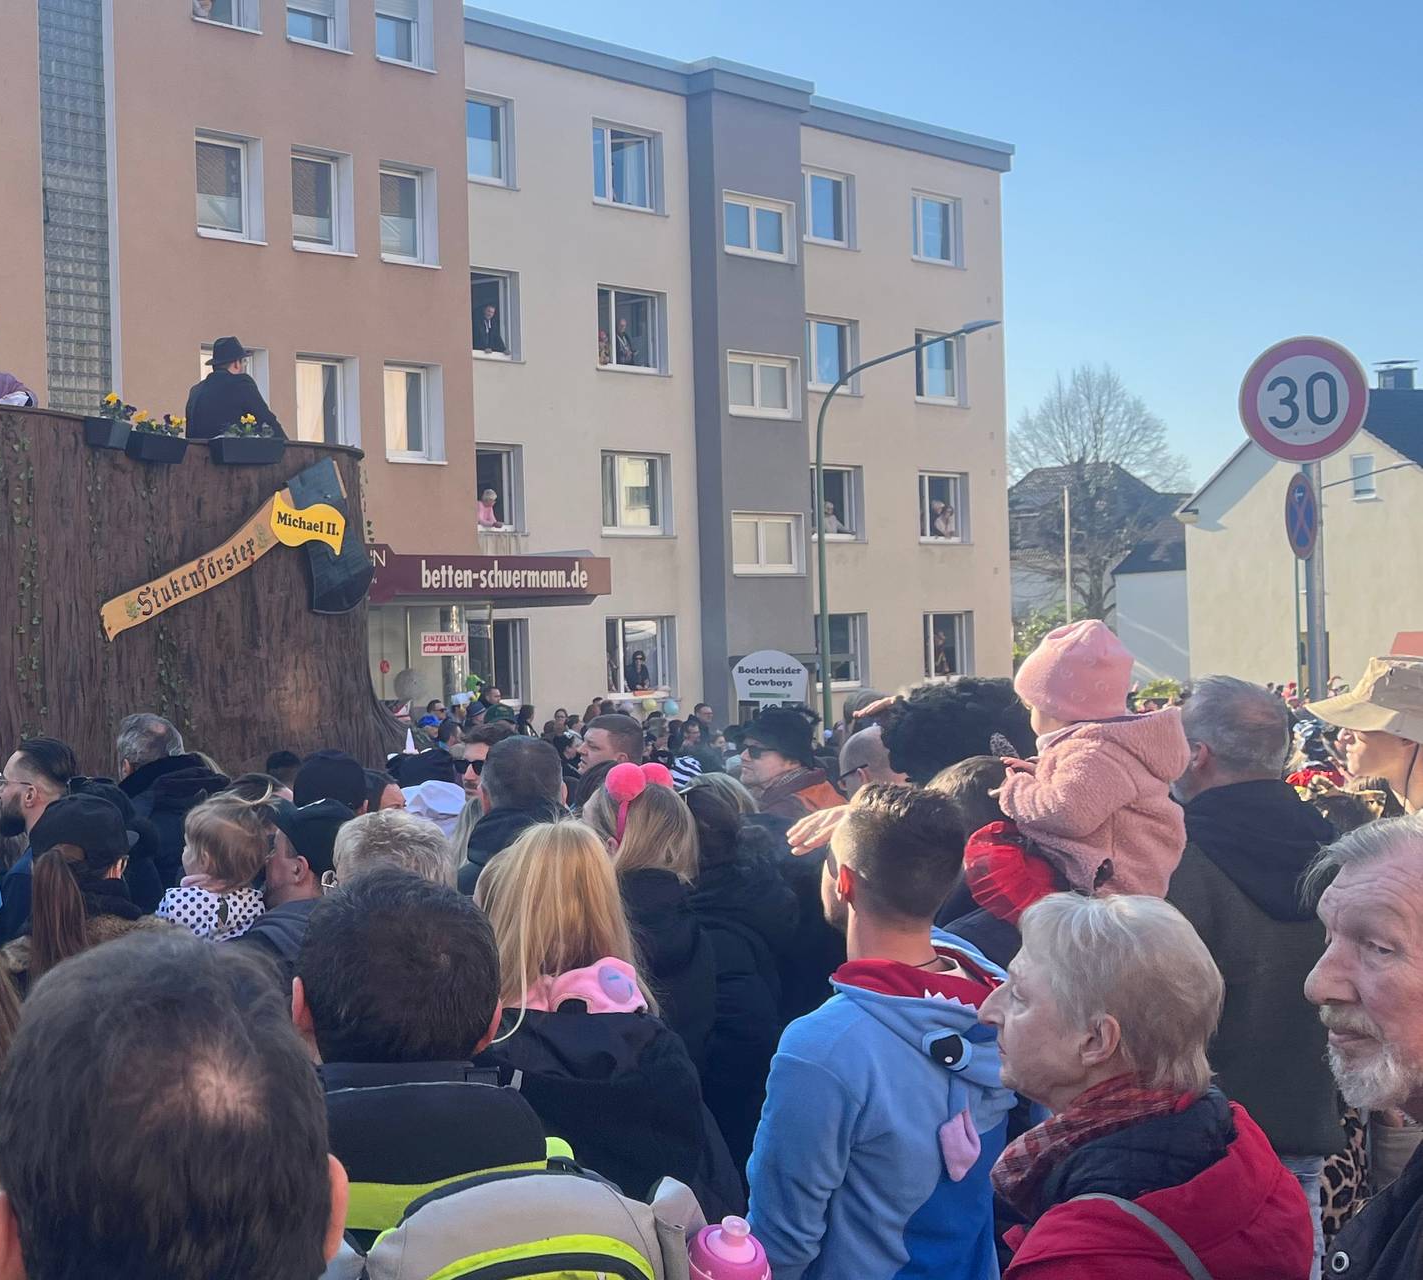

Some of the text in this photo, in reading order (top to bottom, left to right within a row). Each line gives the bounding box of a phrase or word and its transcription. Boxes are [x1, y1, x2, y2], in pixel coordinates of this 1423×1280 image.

[1267, 371, 1339, 429] 30
[276, 511, 340, 536] Michael II.
[136, 536, 256, 616] Stukenförster
[421, 559, 588, 589] betten-schuermann.de
[738, 666, 803, 674] Boelerheider
[747, 678, 793, 688] Cowboys
